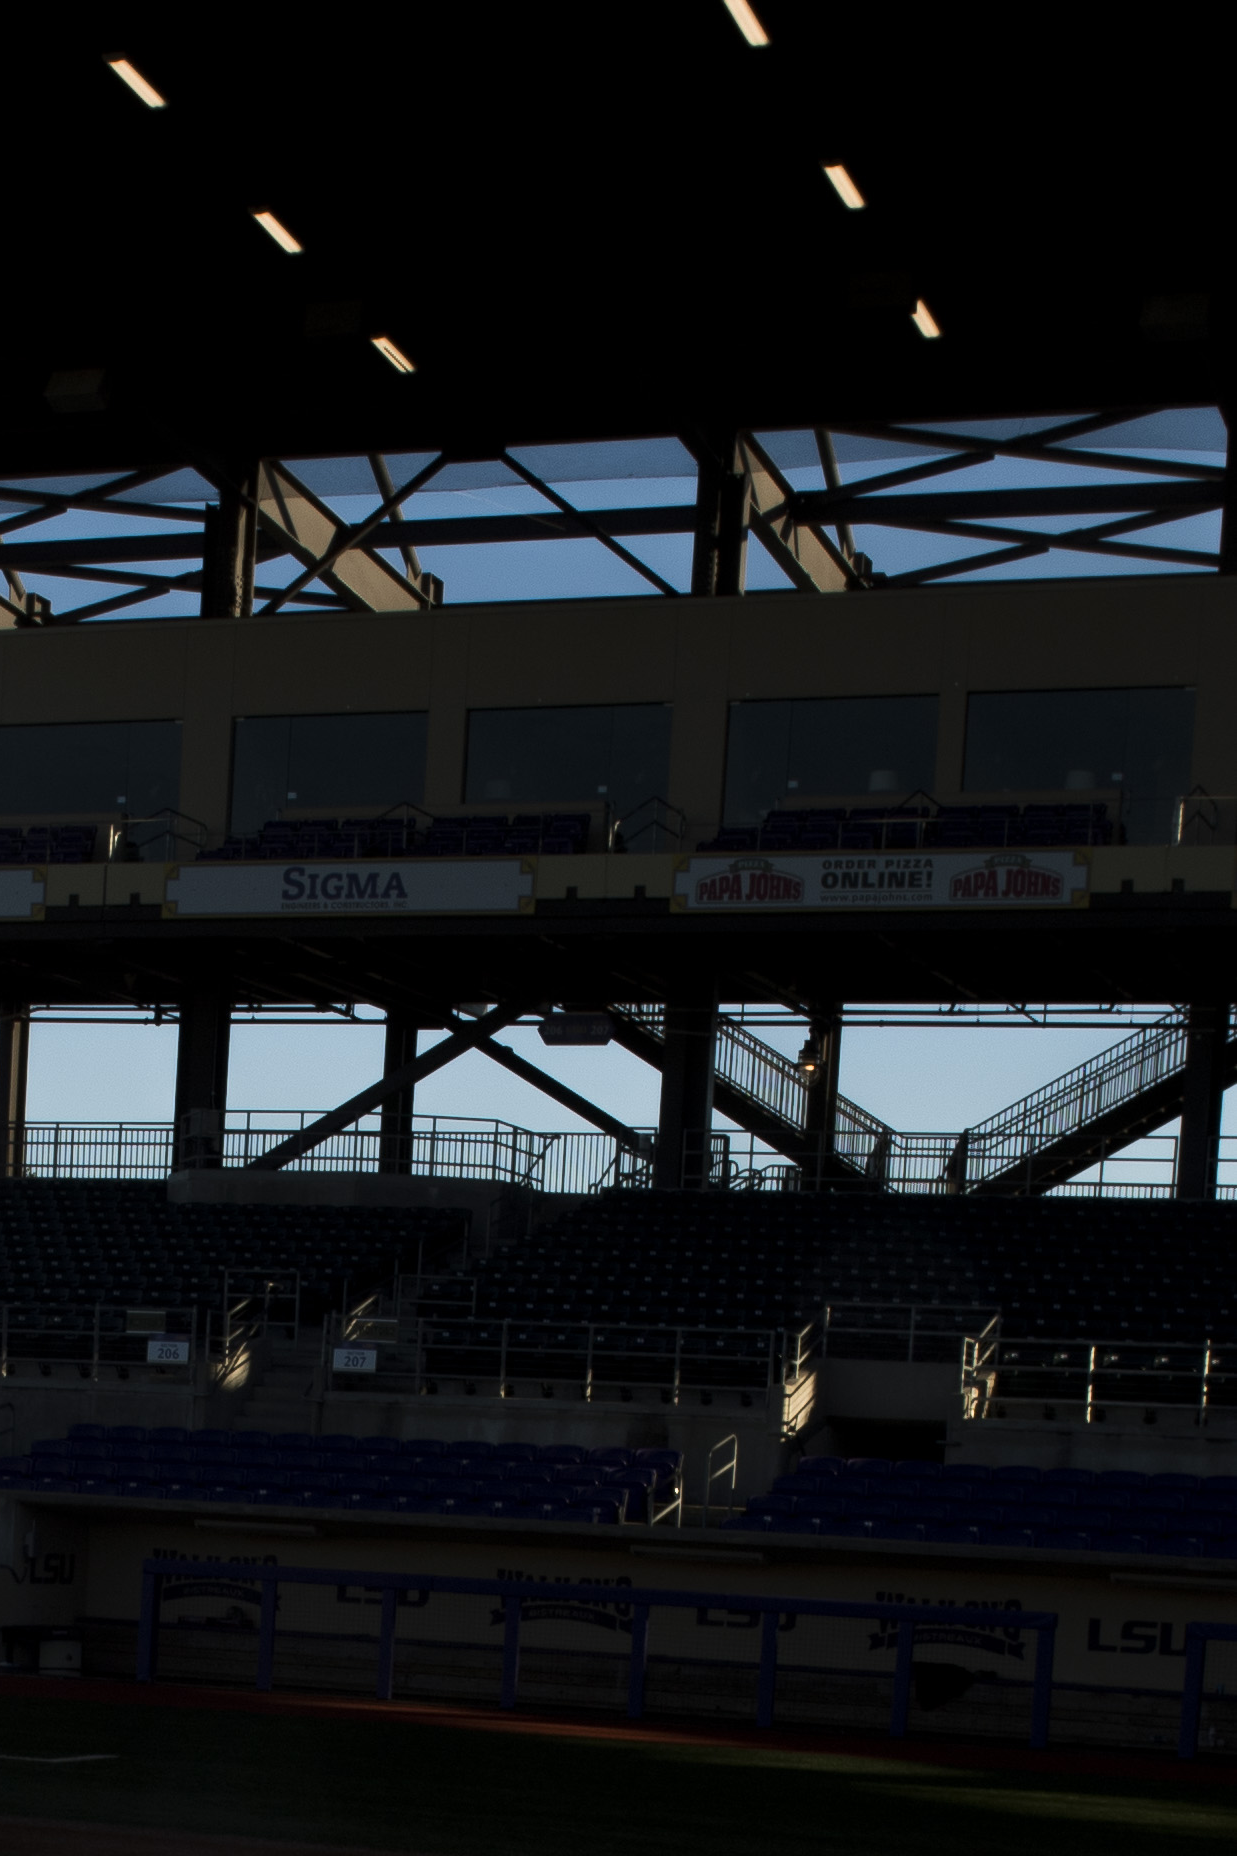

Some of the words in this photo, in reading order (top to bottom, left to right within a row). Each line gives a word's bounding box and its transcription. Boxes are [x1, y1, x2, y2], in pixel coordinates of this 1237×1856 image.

[821, 859, 876, 870] ORDER
[885, 858, 934, 869] PIZZA
[281, 866, 408, 900] SIGMA
[698, 873, 743, 901] PAPA
[745, 872, 802, 901] JOHNS
[820, 871, 933, 889] ONLINE!
[952, 870, 998, 898] PAPA
[1002, 869, 1061, 898] JOHNS
[157, 1348, 180, 1360] 206
[344, 1356, 367, 1368] 207
[30, 1552, 75, 1585] LSU
